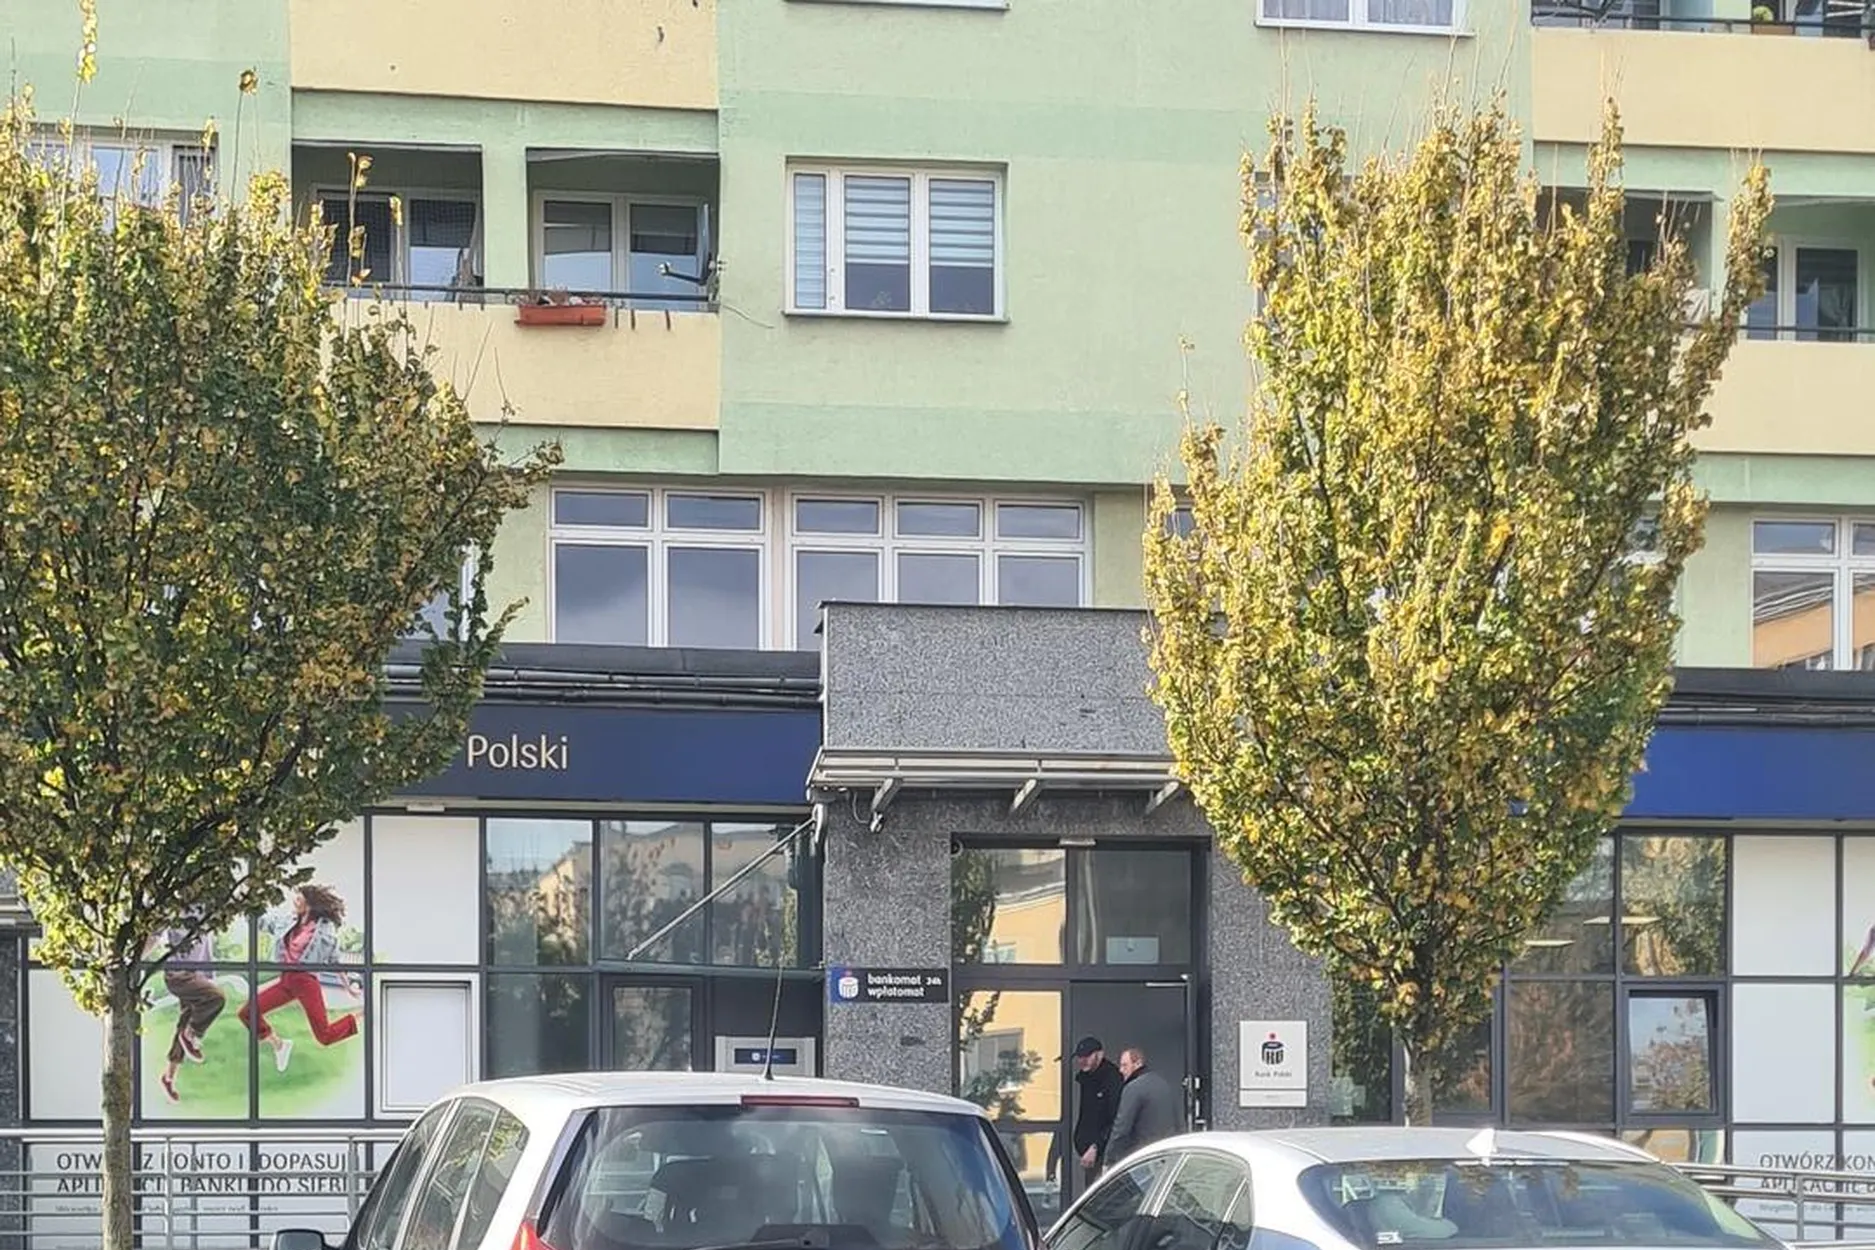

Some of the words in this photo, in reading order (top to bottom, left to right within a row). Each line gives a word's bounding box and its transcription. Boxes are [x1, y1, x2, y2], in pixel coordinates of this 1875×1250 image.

[467, 733, 568, 769] Polski
[867, 973, 921, 985] bankomat
[57, 1152, 154, 1170] OTWZ
[259, 1152, 346, 1172] DOPASUJ
[1760, 1151, 1835, 1170] OTWÓRZ
